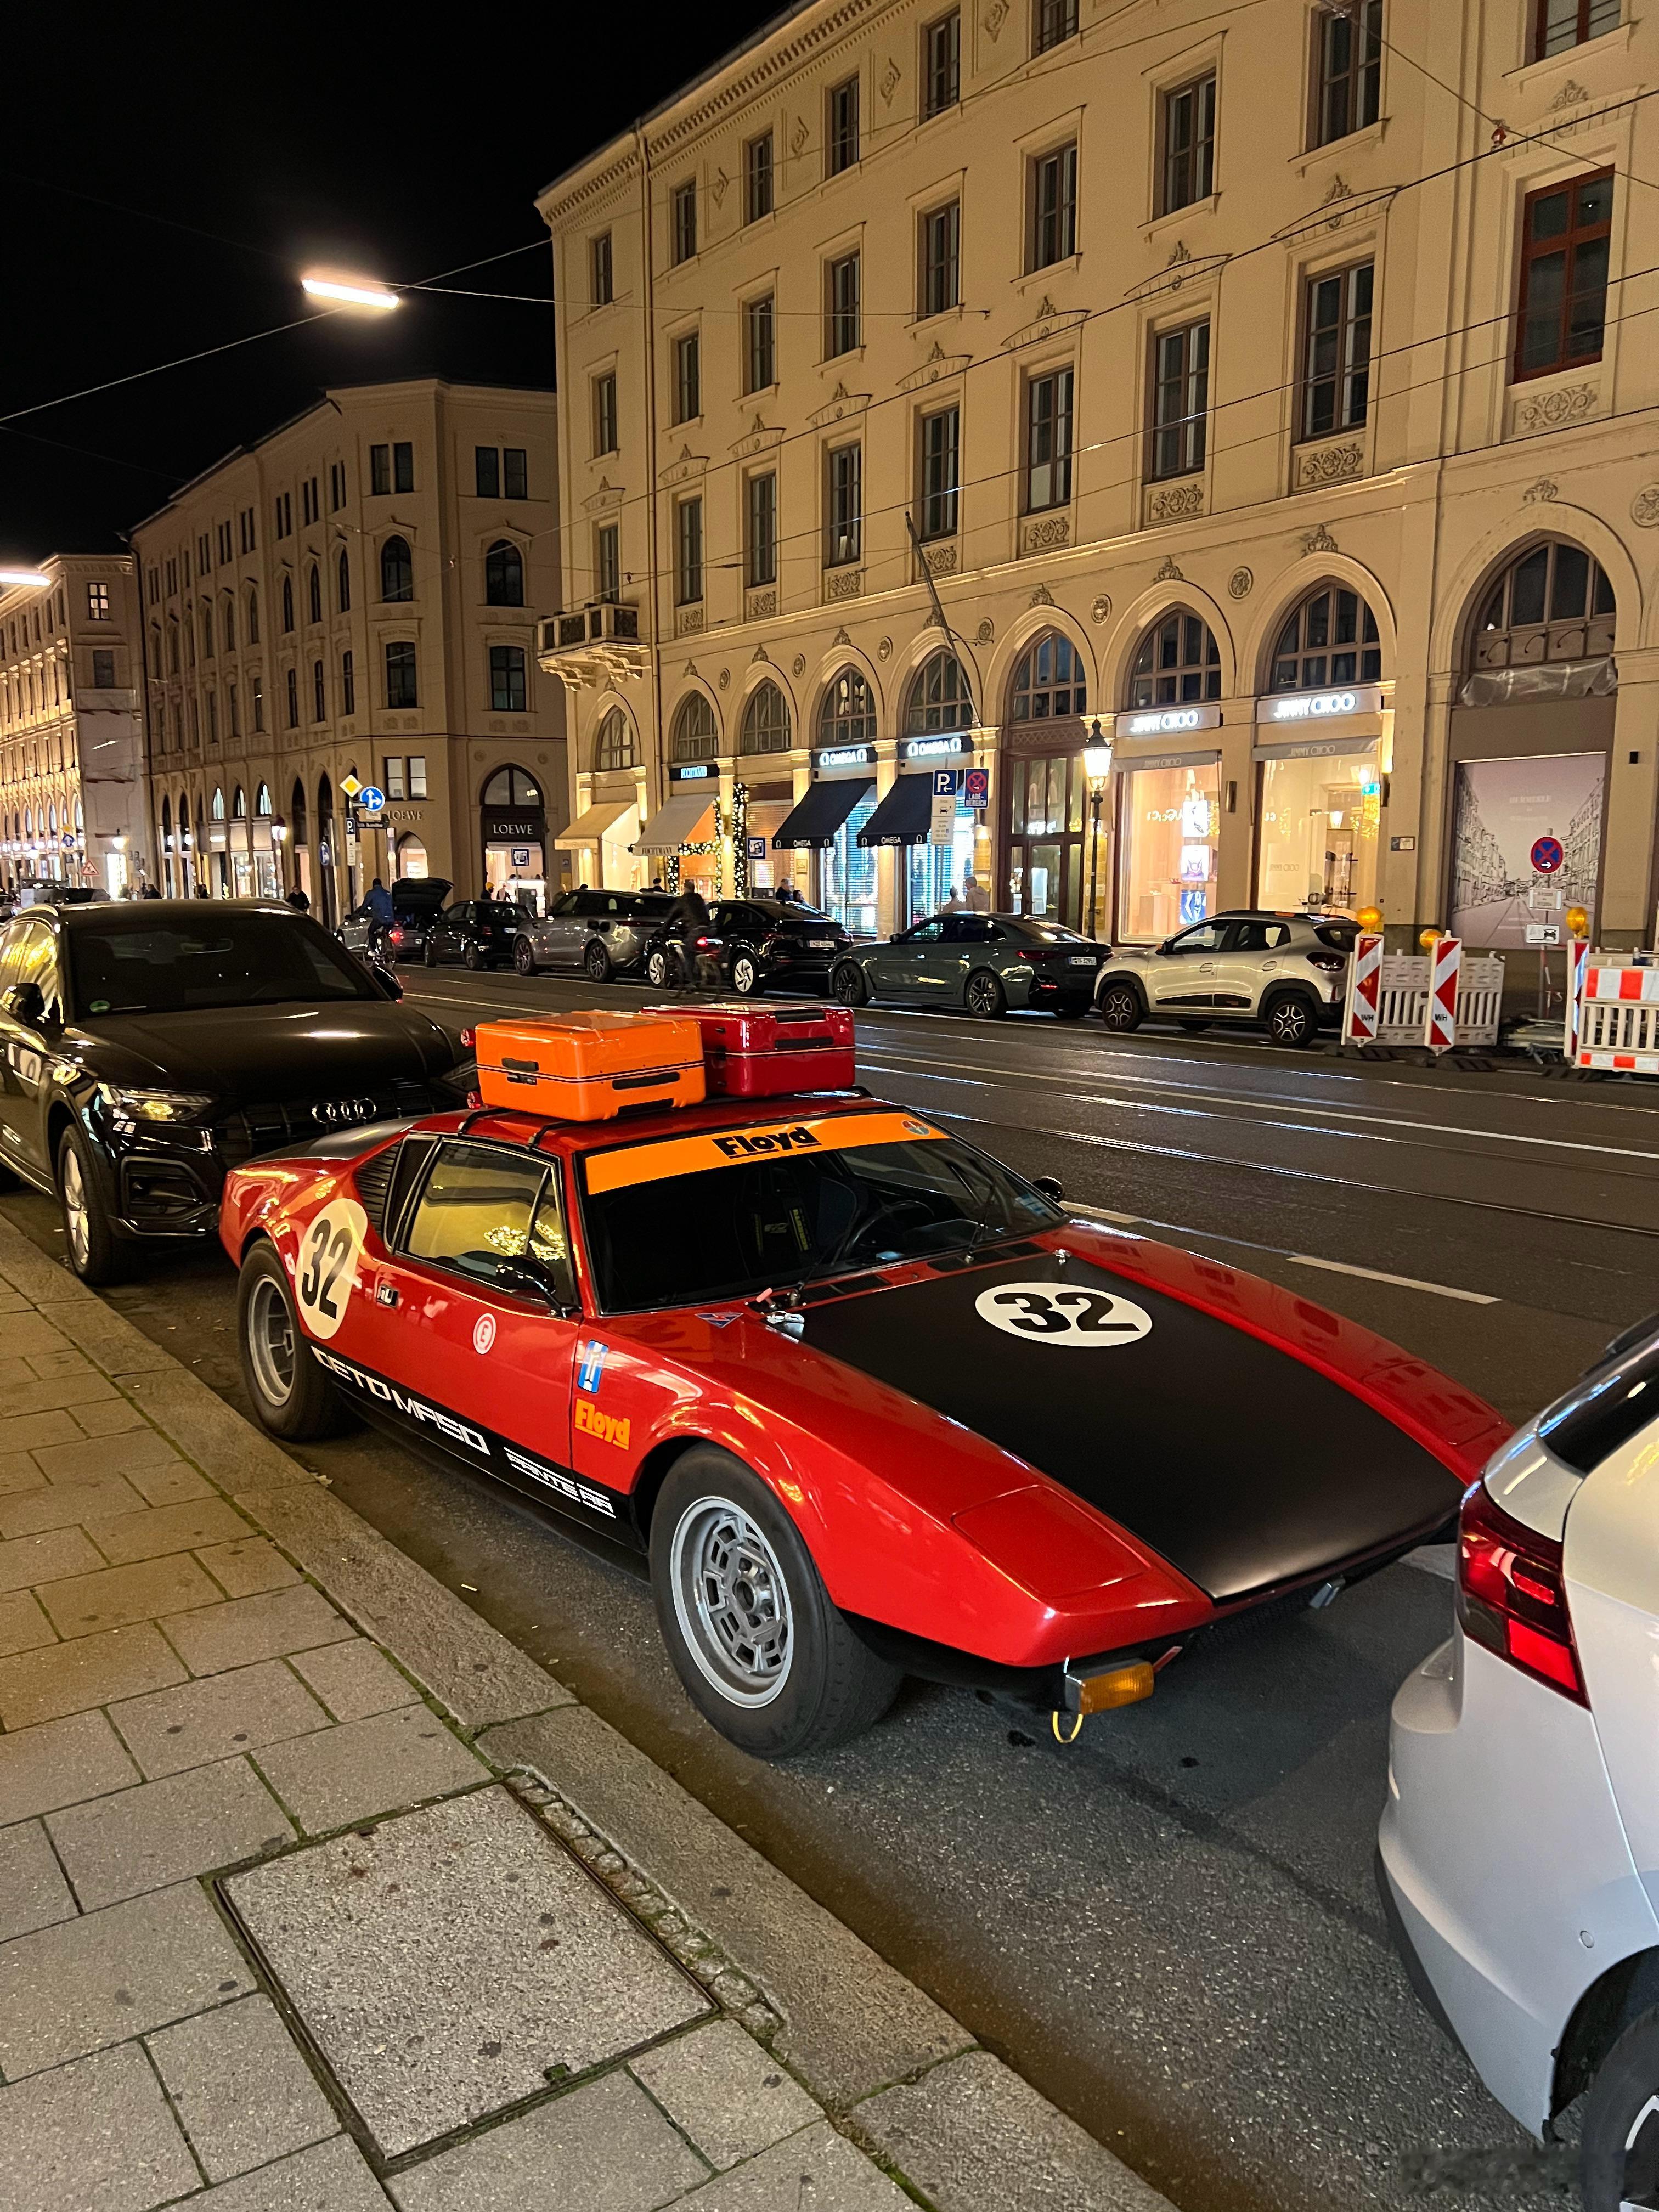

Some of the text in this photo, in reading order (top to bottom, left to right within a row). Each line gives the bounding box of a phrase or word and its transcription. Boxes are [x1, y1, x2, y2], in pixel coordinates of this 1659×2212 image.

[1310, 693, 1356, 714] CHOO
[1161, 710, 1199, 729] CHOO
[918, 741, 950, 755] OMEGA
[1288, 745, 1336, 757] JIMMY CHOO
[830, 751, 857, 765] OMEGA
[1160, 758, 1182, 768] CHOO
[388, 810, 423, 821] LOEWE
[493, 824, 534, 834] LOEWE
[793, 839, 811, 848] OMEGA
[881, 836, 901, 844] OMEGA
[712, 1126, 822, 1158] Floyd
[302, 1219, 353, 1320] 32
[994, 1291, 1141, 1333] 32
[575, 1398, 631, 1449] Floyd
[505, 1452, 614, 1514] PANTERA
